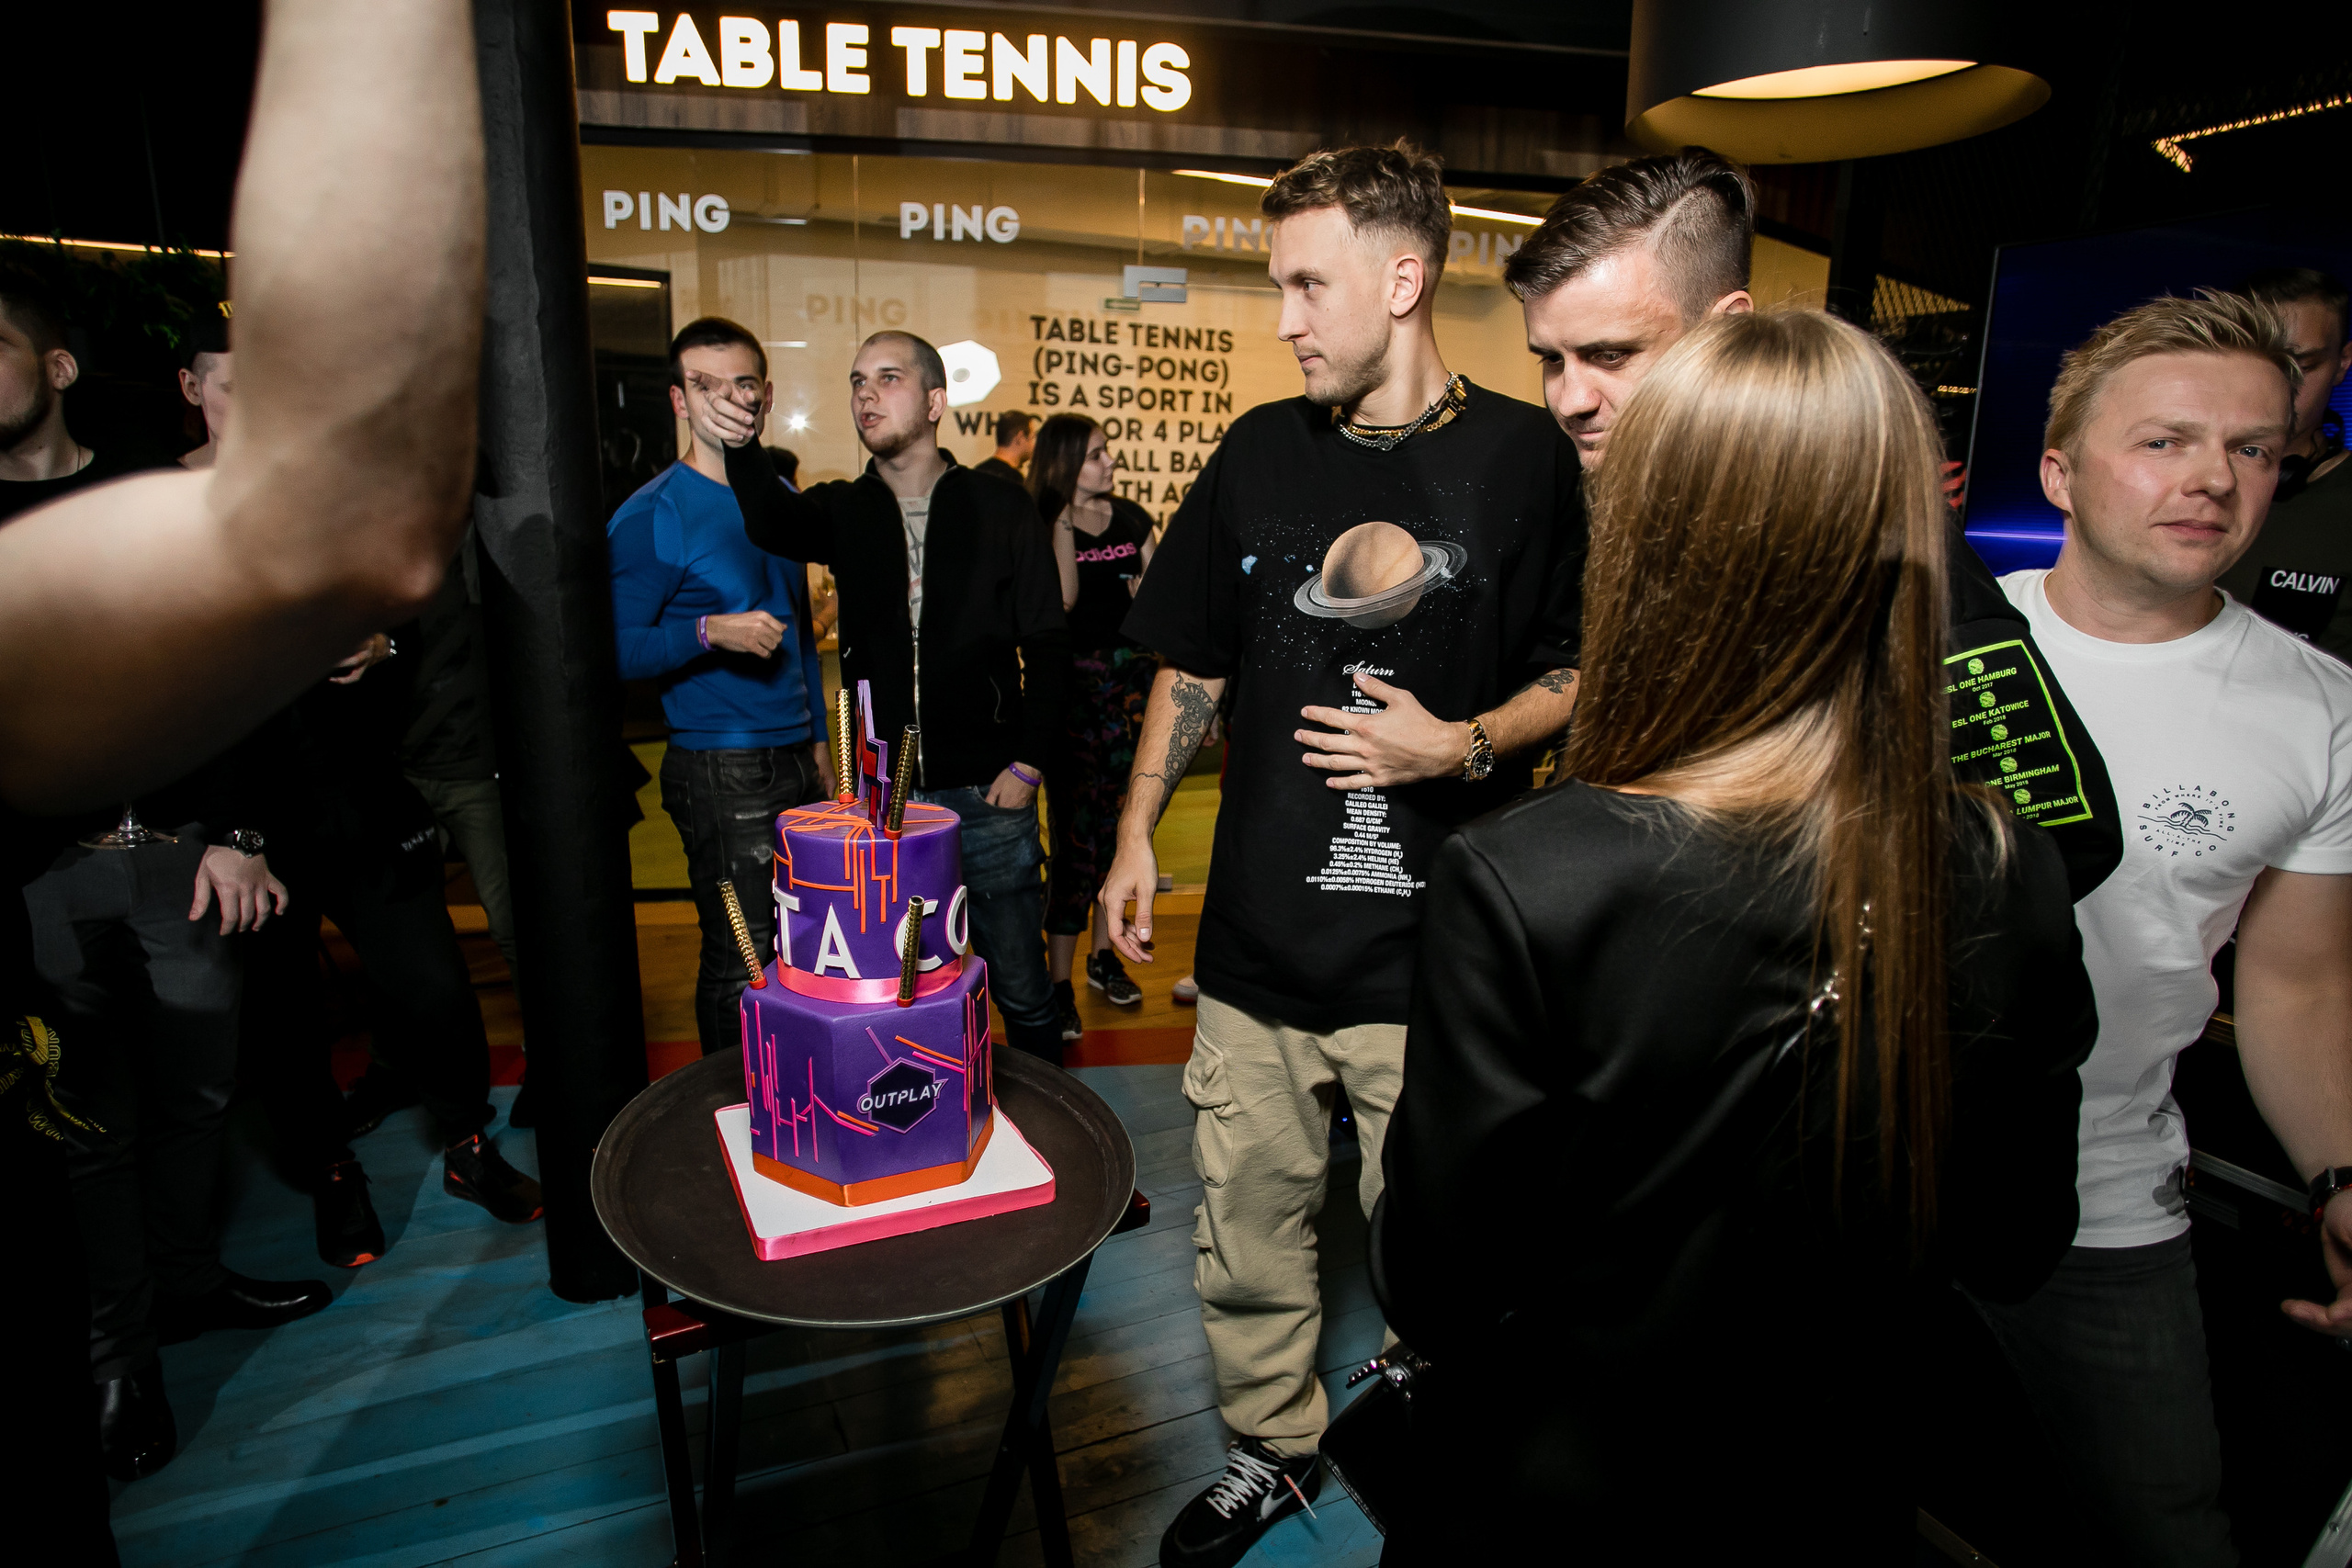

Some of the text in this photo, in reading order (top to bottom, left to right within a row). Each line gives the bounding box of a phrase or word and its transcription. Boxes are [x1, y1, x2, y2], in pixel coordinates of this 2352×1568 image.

[606, 9, 1193, 112] TABLE TENNIS
[603, 188, 731, 234] PING
[899, 201, 1021, 244] PING
[1182, 214, 1274, 254] PIN
[1448, 230, 1523, 268] PIN
[1029, 314, 1119, 345] TABLE
[1127, 322, 1234, 354] TENNIS
[1033, 346, 1230, 389] (PING-PONG)
[1028, 381, 1233, 414] IS A SPORT IN
[1103, 417, 1229, 444] OR 4 PLA
[1114, 449, 1204, 473] ALL BA
[1118, 480, 1152, 503] TH
[1075, 542, 1137, 562] adidas
[2269, 570, 2341, 595] CALVIN
[1342, 660, 1395, 677] Saturn
[1959, 678, 1977, 689] ONE
[1977, 667, 2018, 683] HAMBURG
[1982, 682, 1994, 690] 2017
[1951, 700, 2030, 728] ESL ONE KATOWICE
[1993, 715, 2007, 723] 2018
[1951, 730, 2052, 764] THE BUCHAREST MAJOR
[2004, 763, 2060, 784] BIRMINGHAM
[1345, 799, 1388, 810] GALILEO GALILEI
[1347, 792, 1376, 801] RECORDED
[2016, 795, 2079, 816] LUMPUR MAJOR
[1346, 807, 1387, 818] MEAN DENSITY:
[2142, 784, 2236, 832] BILLABONG
[1342, 822, 1391, 833] SURFACE GRAVITY
[1331, 837, 1369, 846] COMPOSITION
[1377, 841, 1402, 850] VOLUME:
[2139, 824, 2179, 857] SURF
[1363, 847, 1393, 857] HYDROGEN
[1367, 855, 1387, 863] HELIUM
[1363, 863, 1389, 872] METHANE
[1371, 871, 1397, 880] AMMONIA
[1355, 877, 1385, 886] HYDROGEN
[1385, 880, 1415, 888] DEUTERIDE
[1374, 886, 1396, 895] ETHANE
[860, 1080, 944, 1112] OUTPLAY
